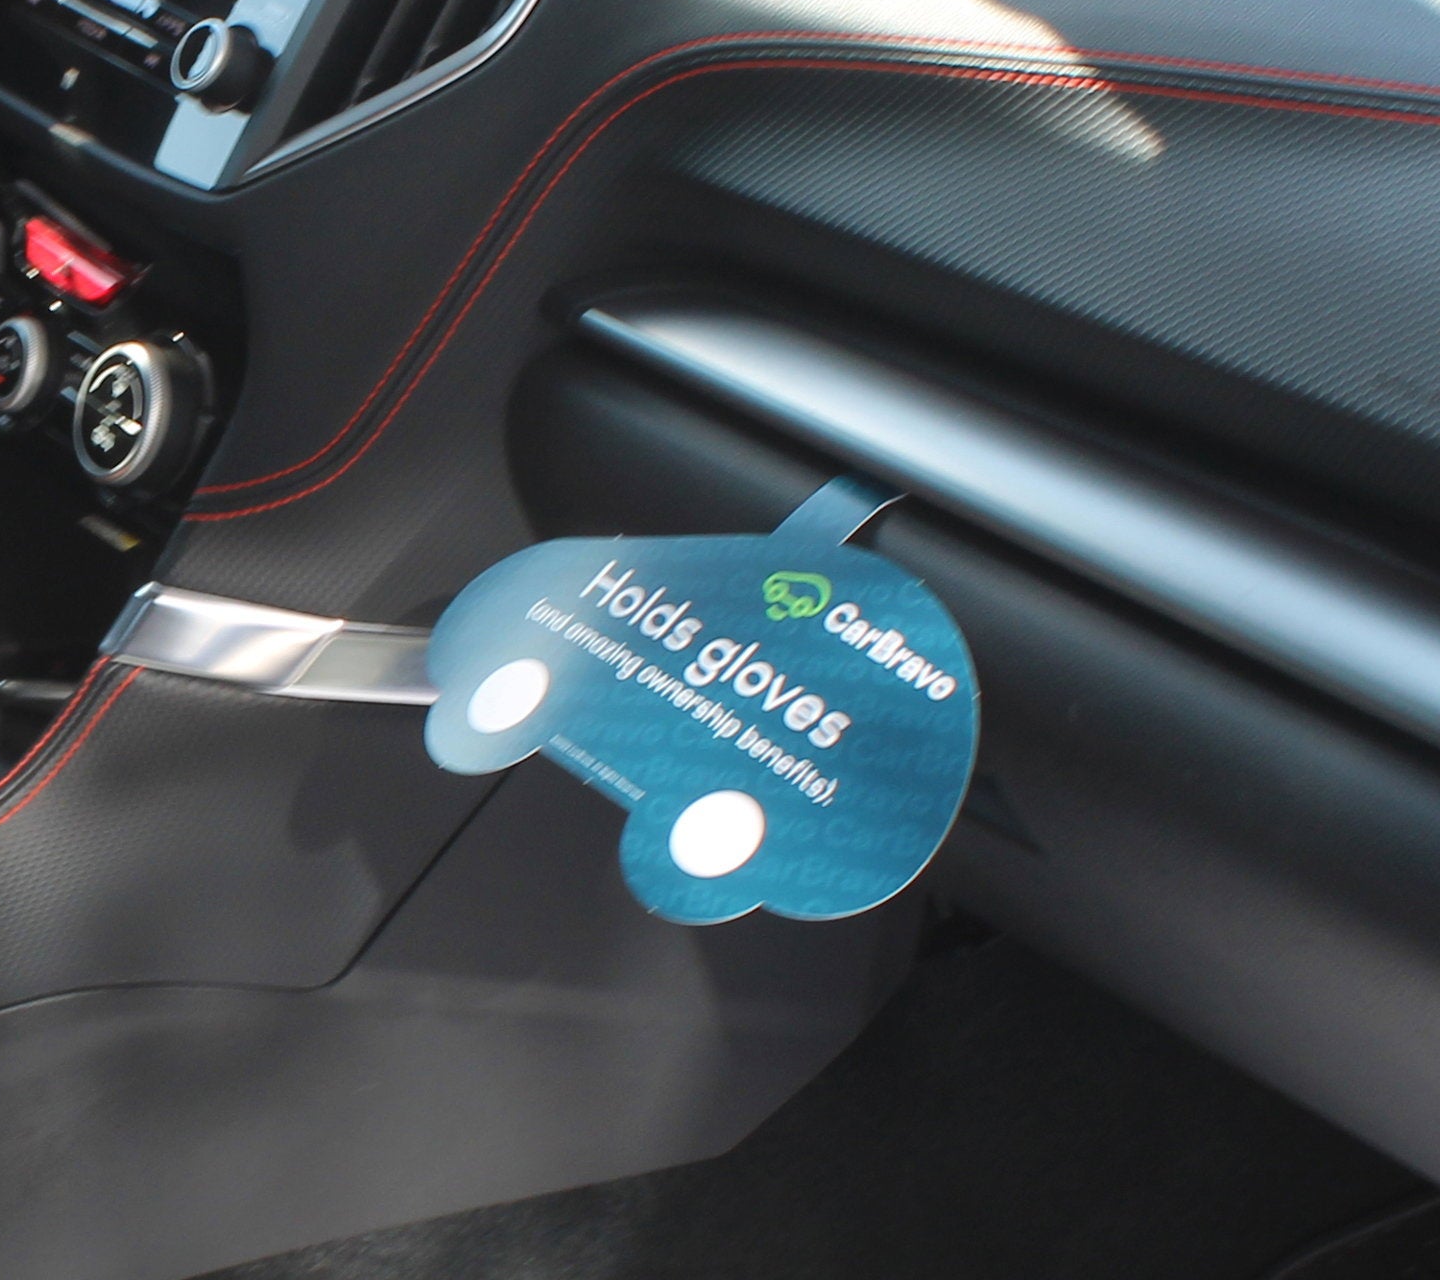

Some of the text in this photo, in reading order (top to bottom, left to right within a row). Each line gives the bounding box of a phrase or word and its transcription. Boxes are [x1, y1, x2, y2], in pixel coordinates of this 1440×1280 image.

[524, 596, 576, 633] (and
[562, 621, 646, 681] amazing
[635, 664, 743, 740] ownership
[579, 559, 852, 750] Holds gloves
[823, 601, 957, 701] CarBravo
